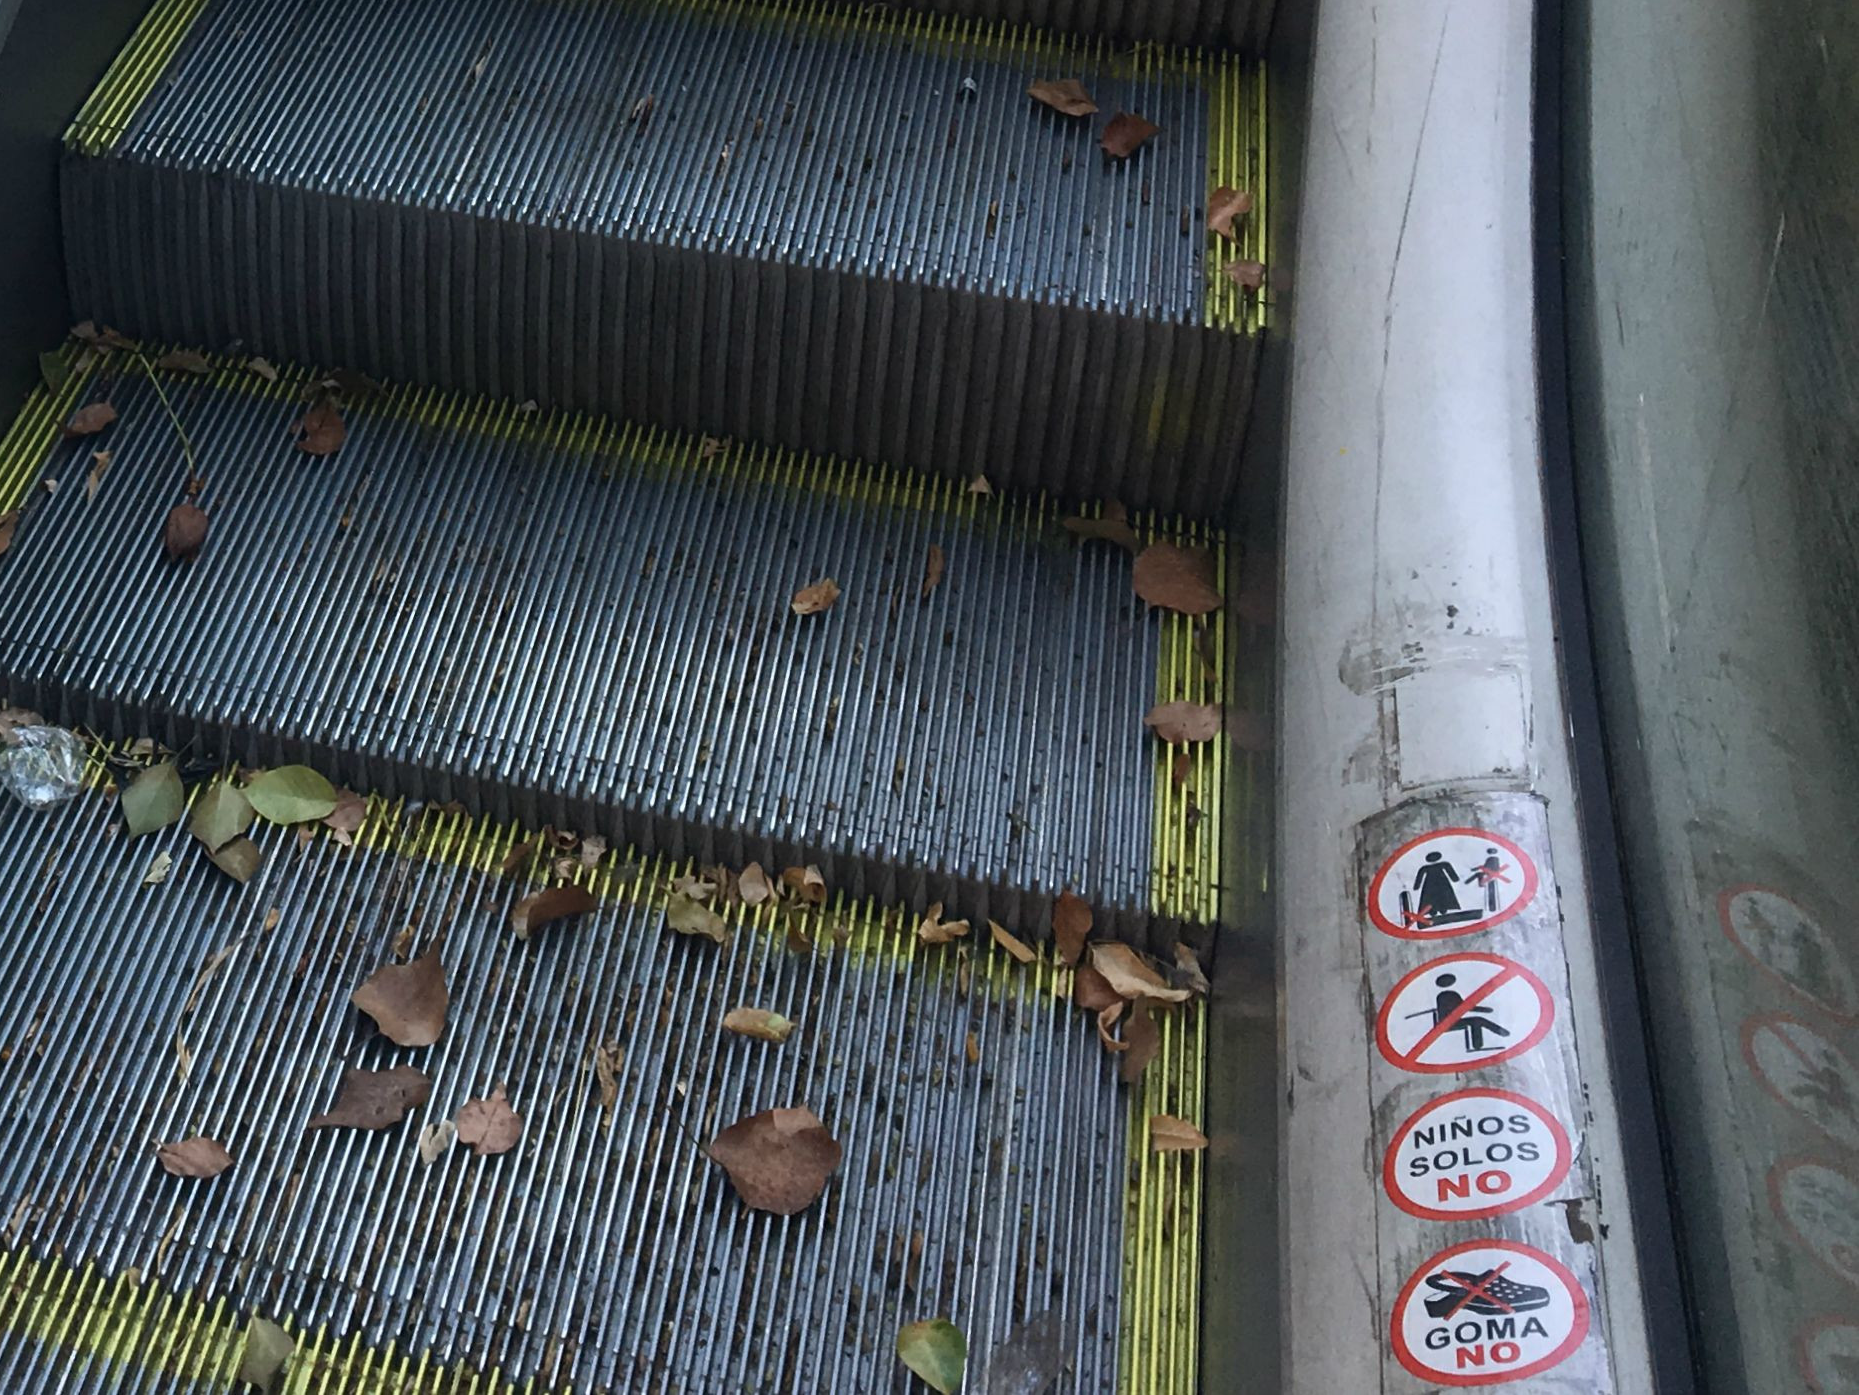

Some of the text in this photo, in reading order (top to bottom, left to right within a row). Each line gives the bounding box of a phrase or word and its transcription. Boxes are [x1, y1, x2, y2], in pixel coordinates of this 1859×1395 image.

[1412, 1114, 1531, 1150] NIÑOS
[1409, 1142, 1540, 1178] SOLOS
[1437, 1170, 1512, 1203] NO
[1424, 1318, 1549, 1350] GOMA
[1455, 1341, 1522, 1370] NO
